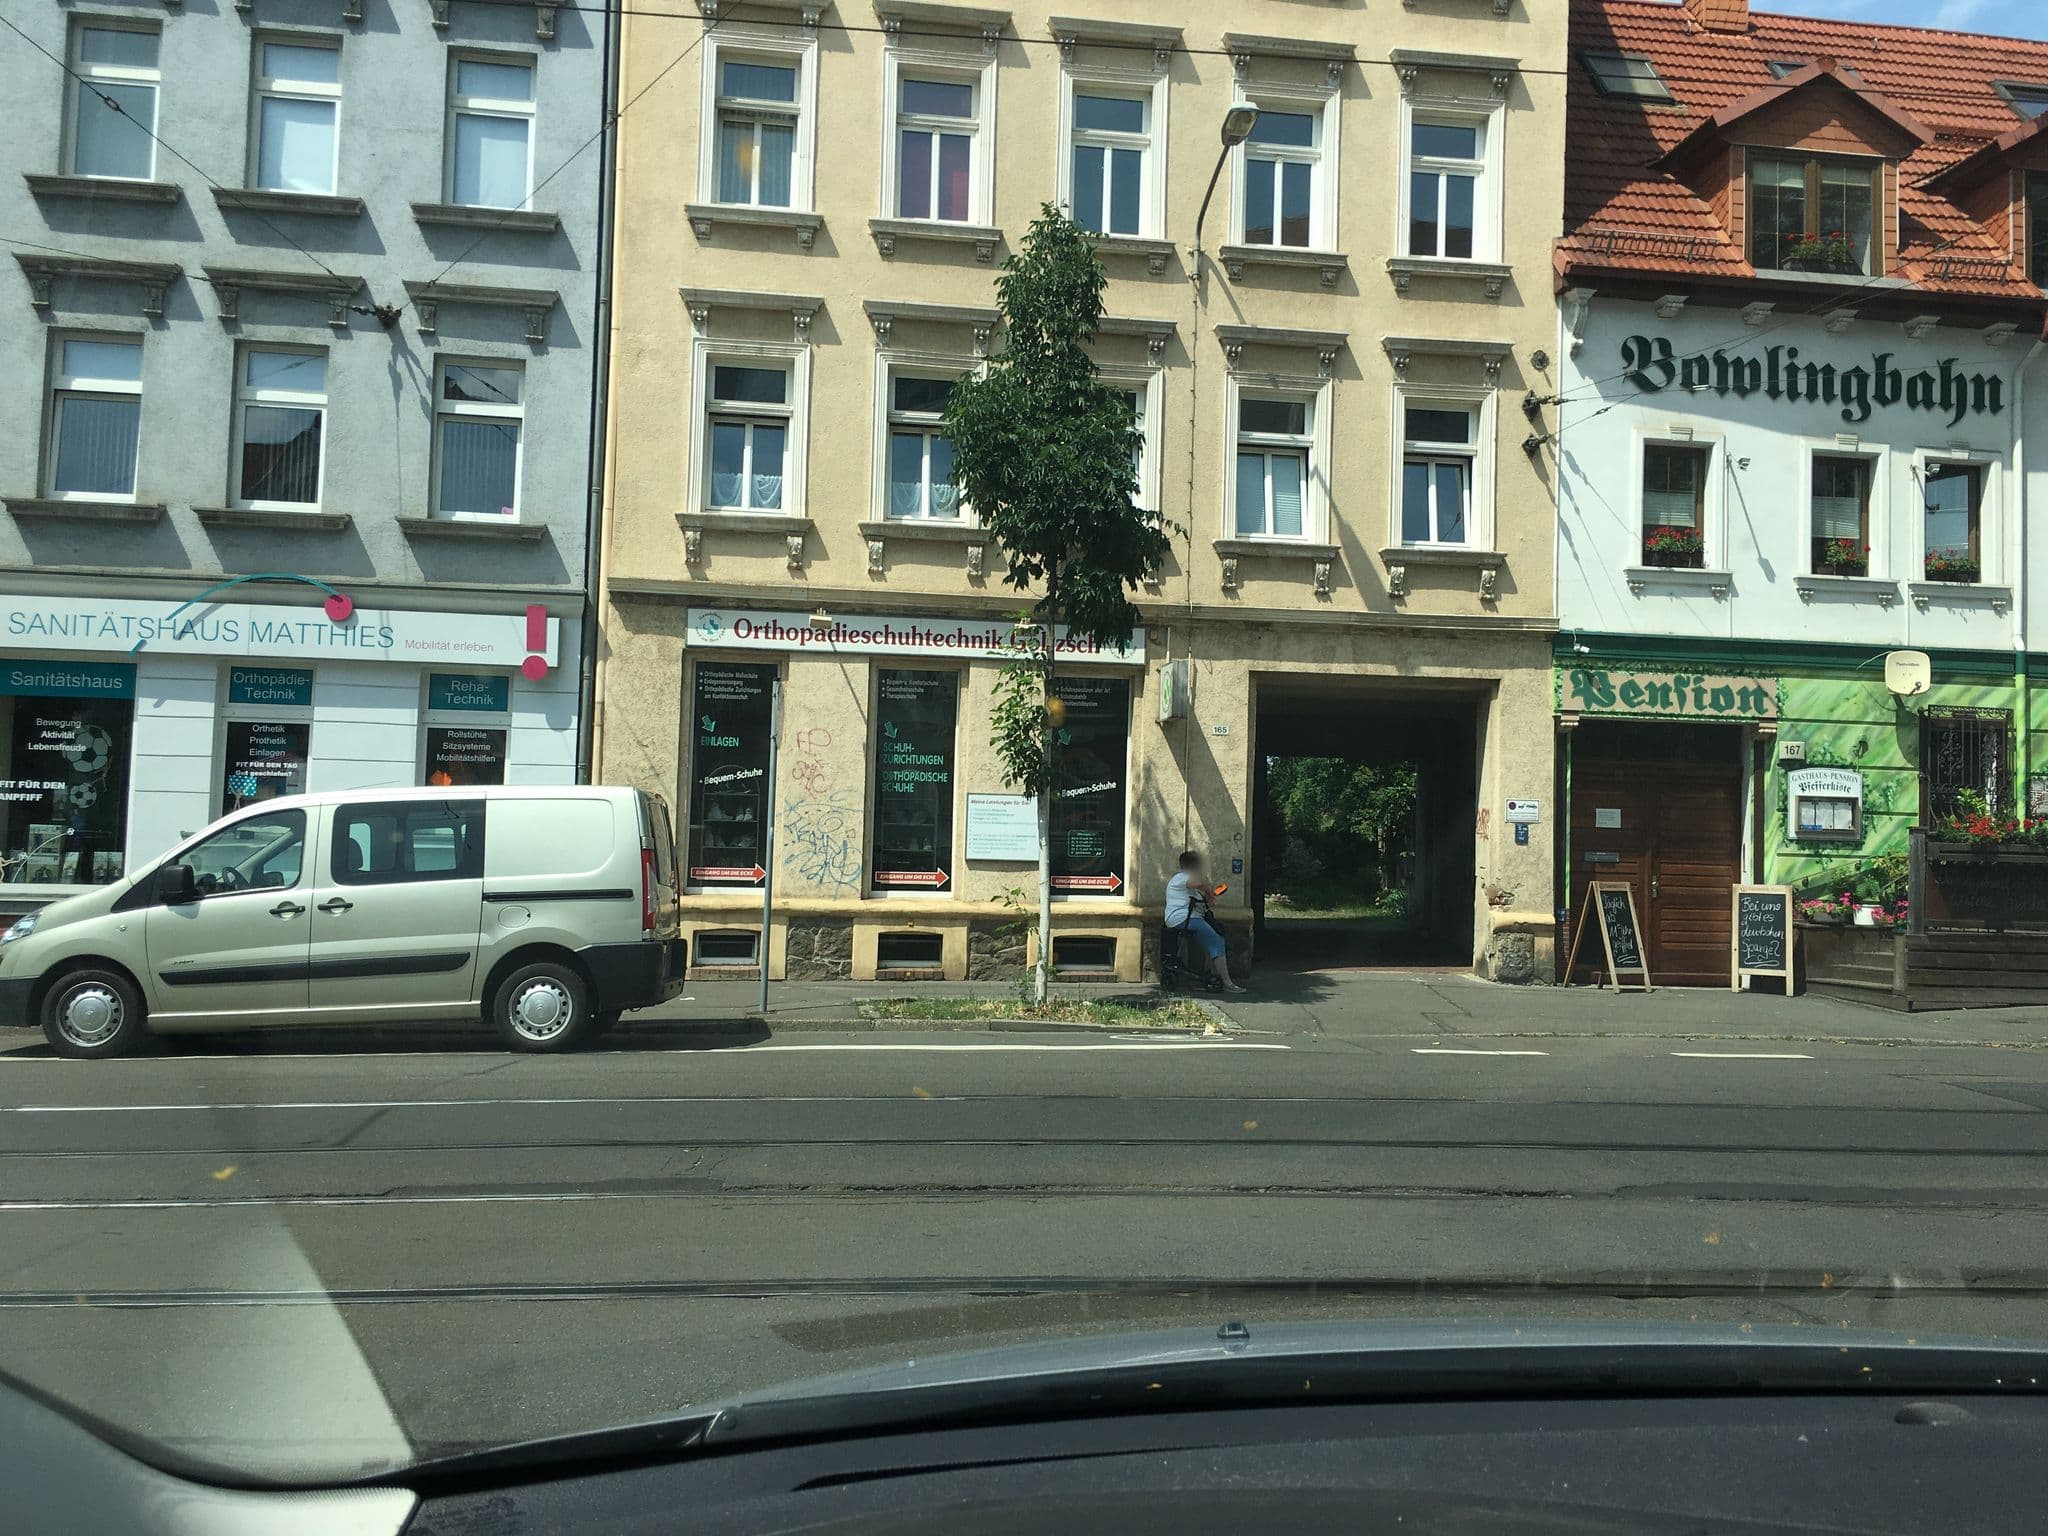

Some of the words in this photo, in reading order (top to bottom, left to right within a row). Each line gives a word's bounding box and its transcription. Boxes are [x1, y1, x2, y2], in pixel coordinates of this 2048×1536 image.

[1620, 335, 2005, 428] Bowlingbahn
[8, 611, 239, 643] SANITÄTSHAUS
[250, 620, 394, 649] MATTHIES
[405, 639, 451, 652] Mobilität
[453, 641, 494, 653] erleben
[11, 671, 123, 690] Sanitätshaus
[233, 672, 310, 687] Orthopädie-
[451, 680, 489, 693] Reha-
[1569, 669, 1769, 715] Pension
[244, 687, 296, 700] Technik
[445, 692, 494, 705] Technik
[36, 718, 82, 728] Bewegung
[252, 724, 285, 733] Orthetik
[41, 730, 75, 739] Aktivität
[447, 730, 488, 739] Rollstühle
[1213, 726, 1228, 734] 165
[249, 736, 287, 745] Prothetik
[701, 735, 740, 747] EINLAGEN
[28, 742, 87, 752] Lebensfreude
[442, 742, 491, 752] Sitzsysteme
[883, 742, 915, 753] SCHUH-
[1785, 745, 1801, 755] 167
[249, 748, 286, 758] Einlagen
[436, 753, 496, 763] Mobilitätshilfen
[882, 753, 944, 765] ZURICHTUNGEN
[704, 768, 763, 785] Bequem-Schuhe
[18, 780, 40, 789] FÜR
[43, 781, 66, 790] DEN
[881, 782, 914, 793] SCHUHE
[1741, 897, 1760, 912] Bei
